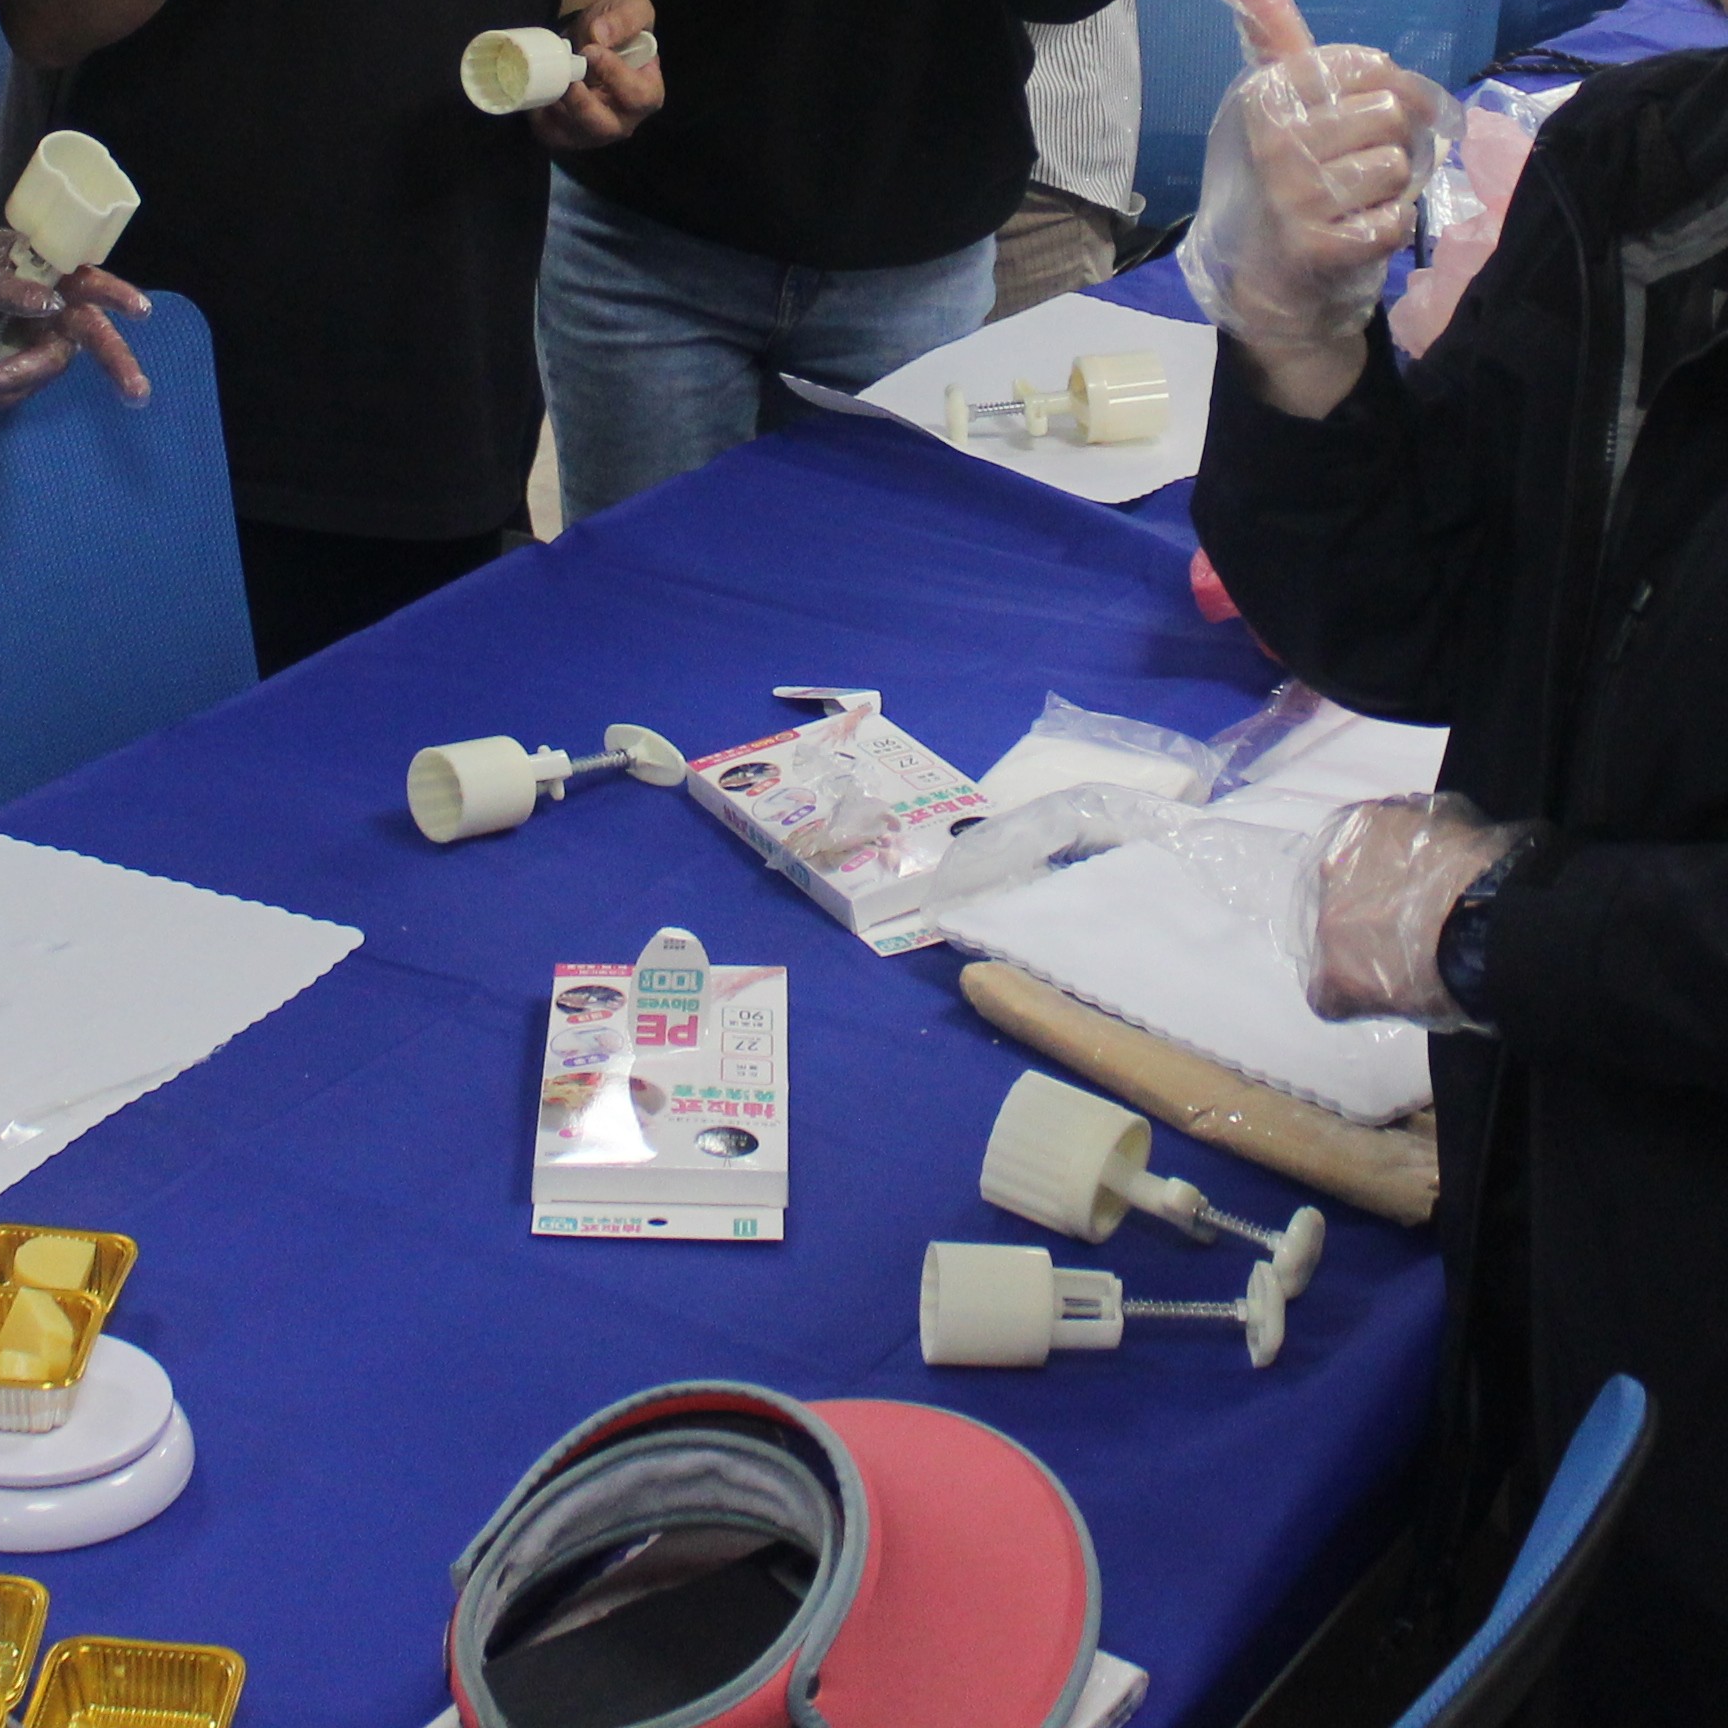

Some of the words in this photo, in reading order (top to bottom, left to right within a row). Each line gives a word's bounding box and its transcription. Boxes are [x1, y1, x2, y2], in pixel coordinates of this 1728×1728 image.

[636, 997, 700, 1013] Gloves
[635, 1014, 698, 1047] PE
[671, 1098, 776, 1120] 抽取式
